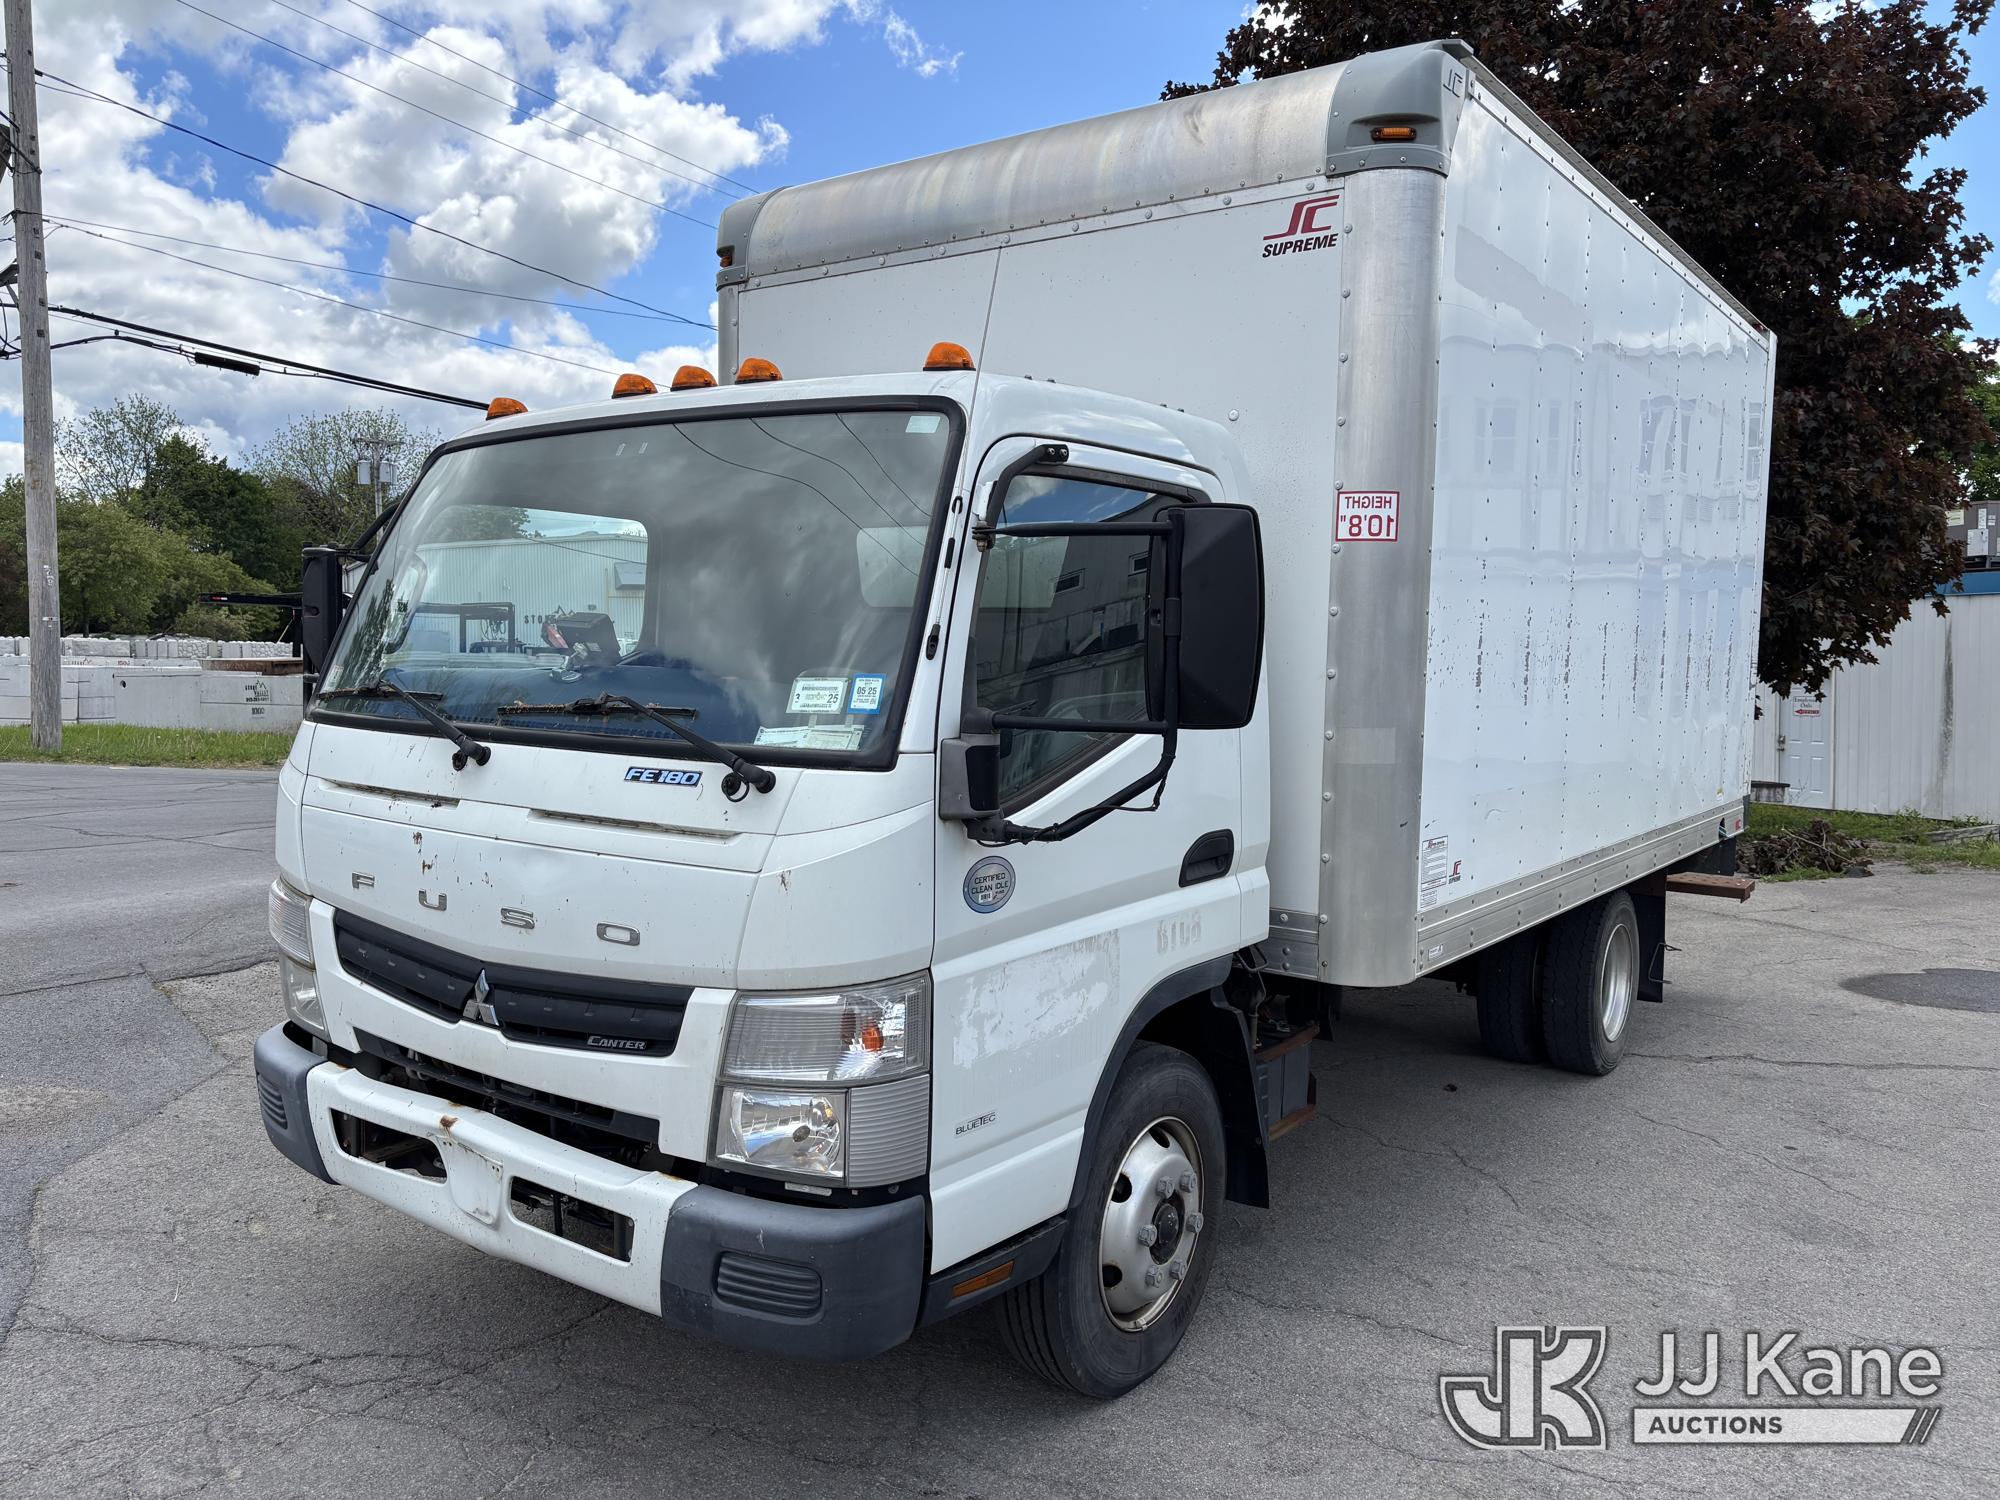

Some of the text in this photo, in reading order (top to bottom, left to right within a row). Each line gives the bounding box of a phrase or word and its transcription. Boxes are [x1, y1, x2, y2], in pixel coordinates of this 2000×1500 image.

[1262, 233, 1338, 258] SUPREME
[868, 686, 878, 695] 25
[827, 693, 839, 704] 25
[974, 872, 1006, 885] CERTIFIED
[971, 884, 993, 895] CLEAN
[995, 880, 1009, 890] IDLE
[351, 871, 641, 947] FUSO
[586, 1035, 647, 1050] CANTER
[955, 1111, 997, 1136] BLUETEC
